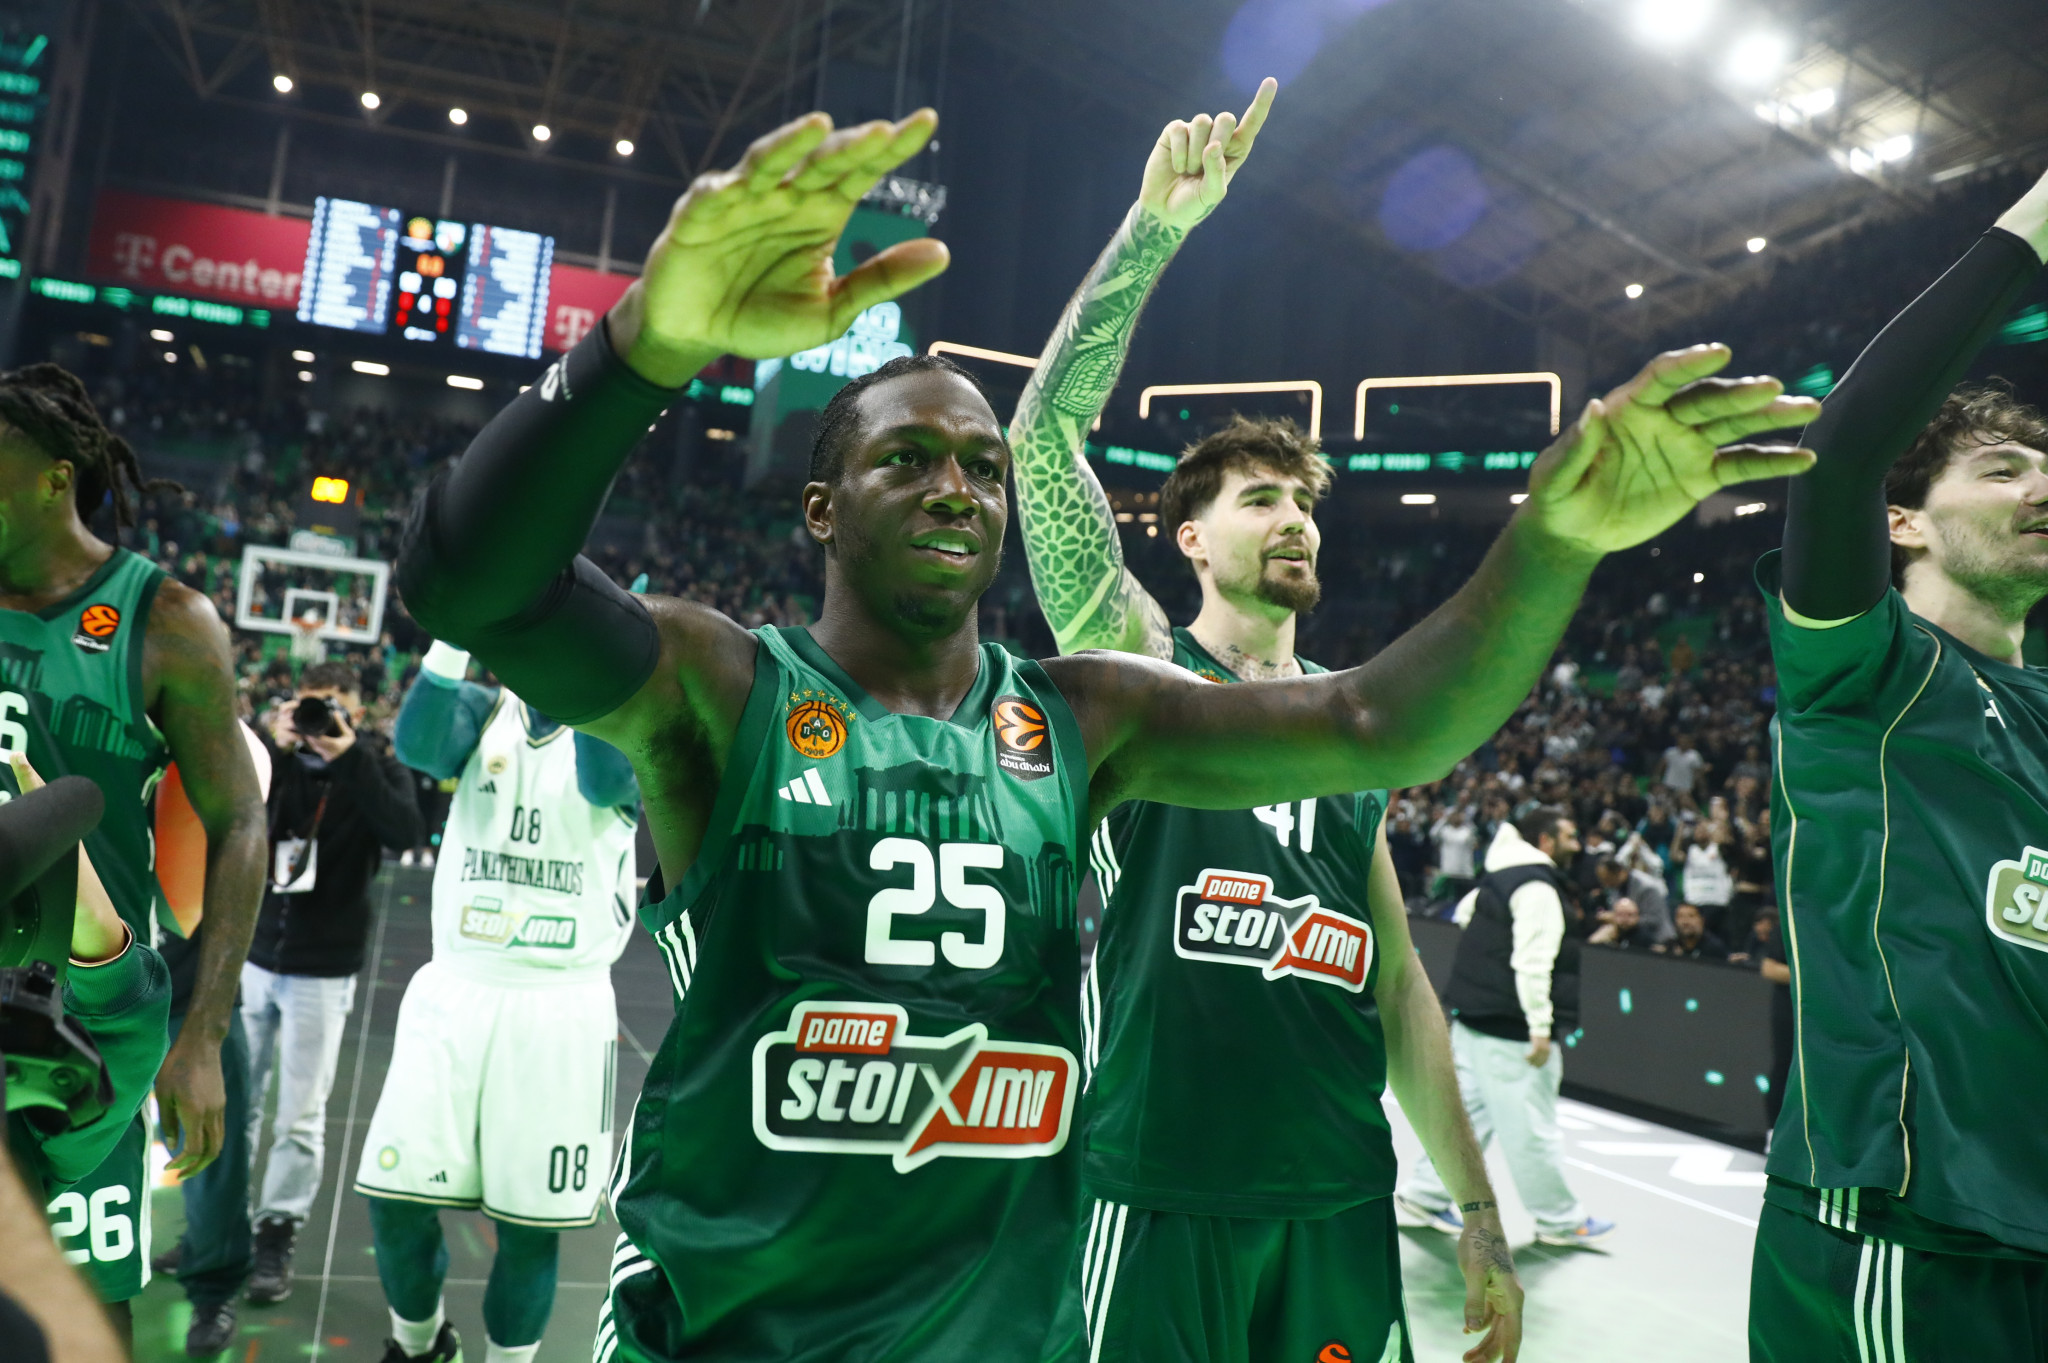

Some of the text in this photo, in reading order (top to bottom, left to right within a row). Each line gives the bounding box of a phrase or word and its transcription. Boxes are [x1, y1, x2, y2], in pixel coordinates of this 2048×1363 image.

[162, 244, 300, 300] Center
[1000, 759, 1050, 773] abu dhabi
[510, 805, 541, 844] 08
[1253, 797, 1317, 853] 41
[865, 837, 1006, 969] 25
[1206, 879, 1261, 900] pame
[803, 1016, 888, 1048] pame
[549, 1144, 589, 1193] 08
[47, 1184, 134, 1265] 26
